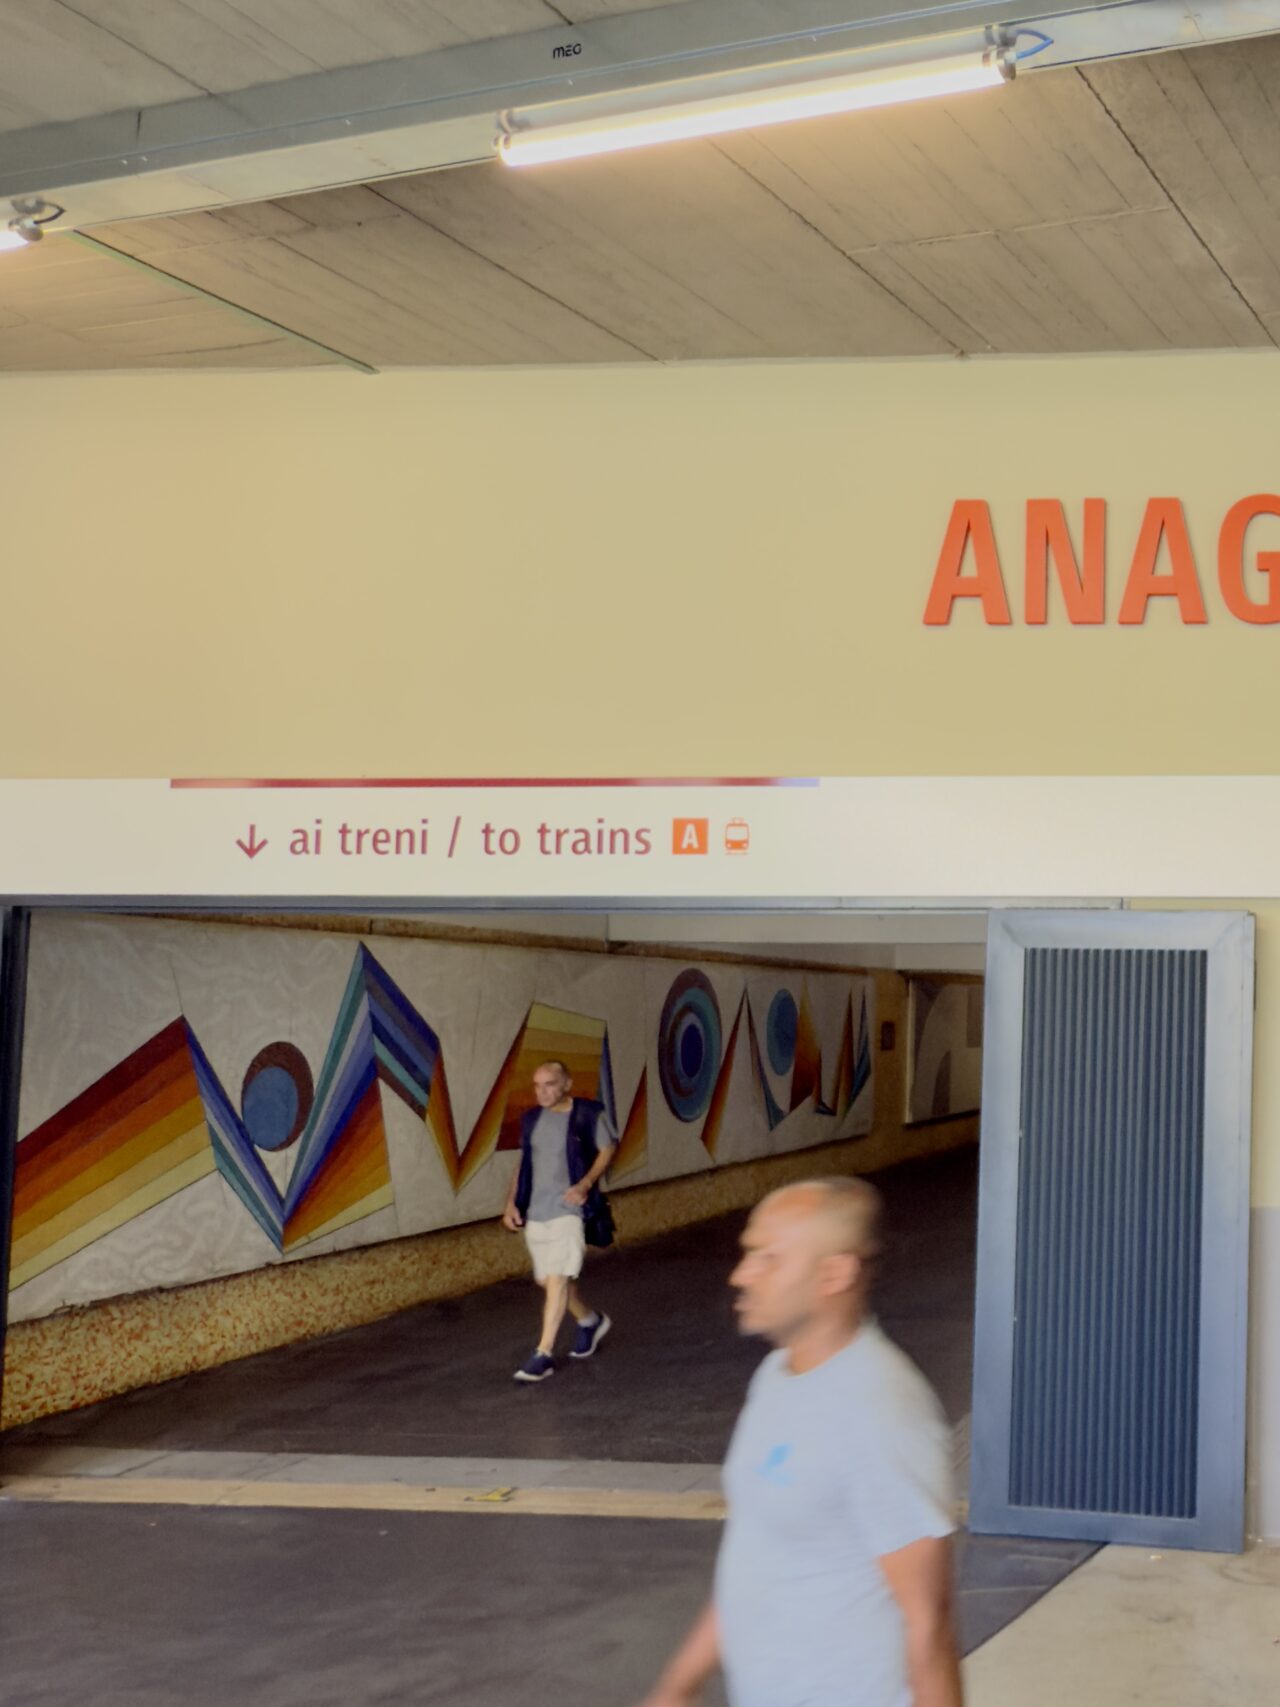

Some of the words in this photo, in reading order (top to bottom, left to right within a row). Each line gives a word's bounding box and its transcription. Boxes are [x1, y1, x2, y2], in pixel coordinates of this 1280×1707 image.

[289, 818, 323, 856] ai
[338, 818, 429, 856] treni
[447, 815, 462, 859] /
[481, 821, 521, 856] to
[536, 818, 653, 856] trains
